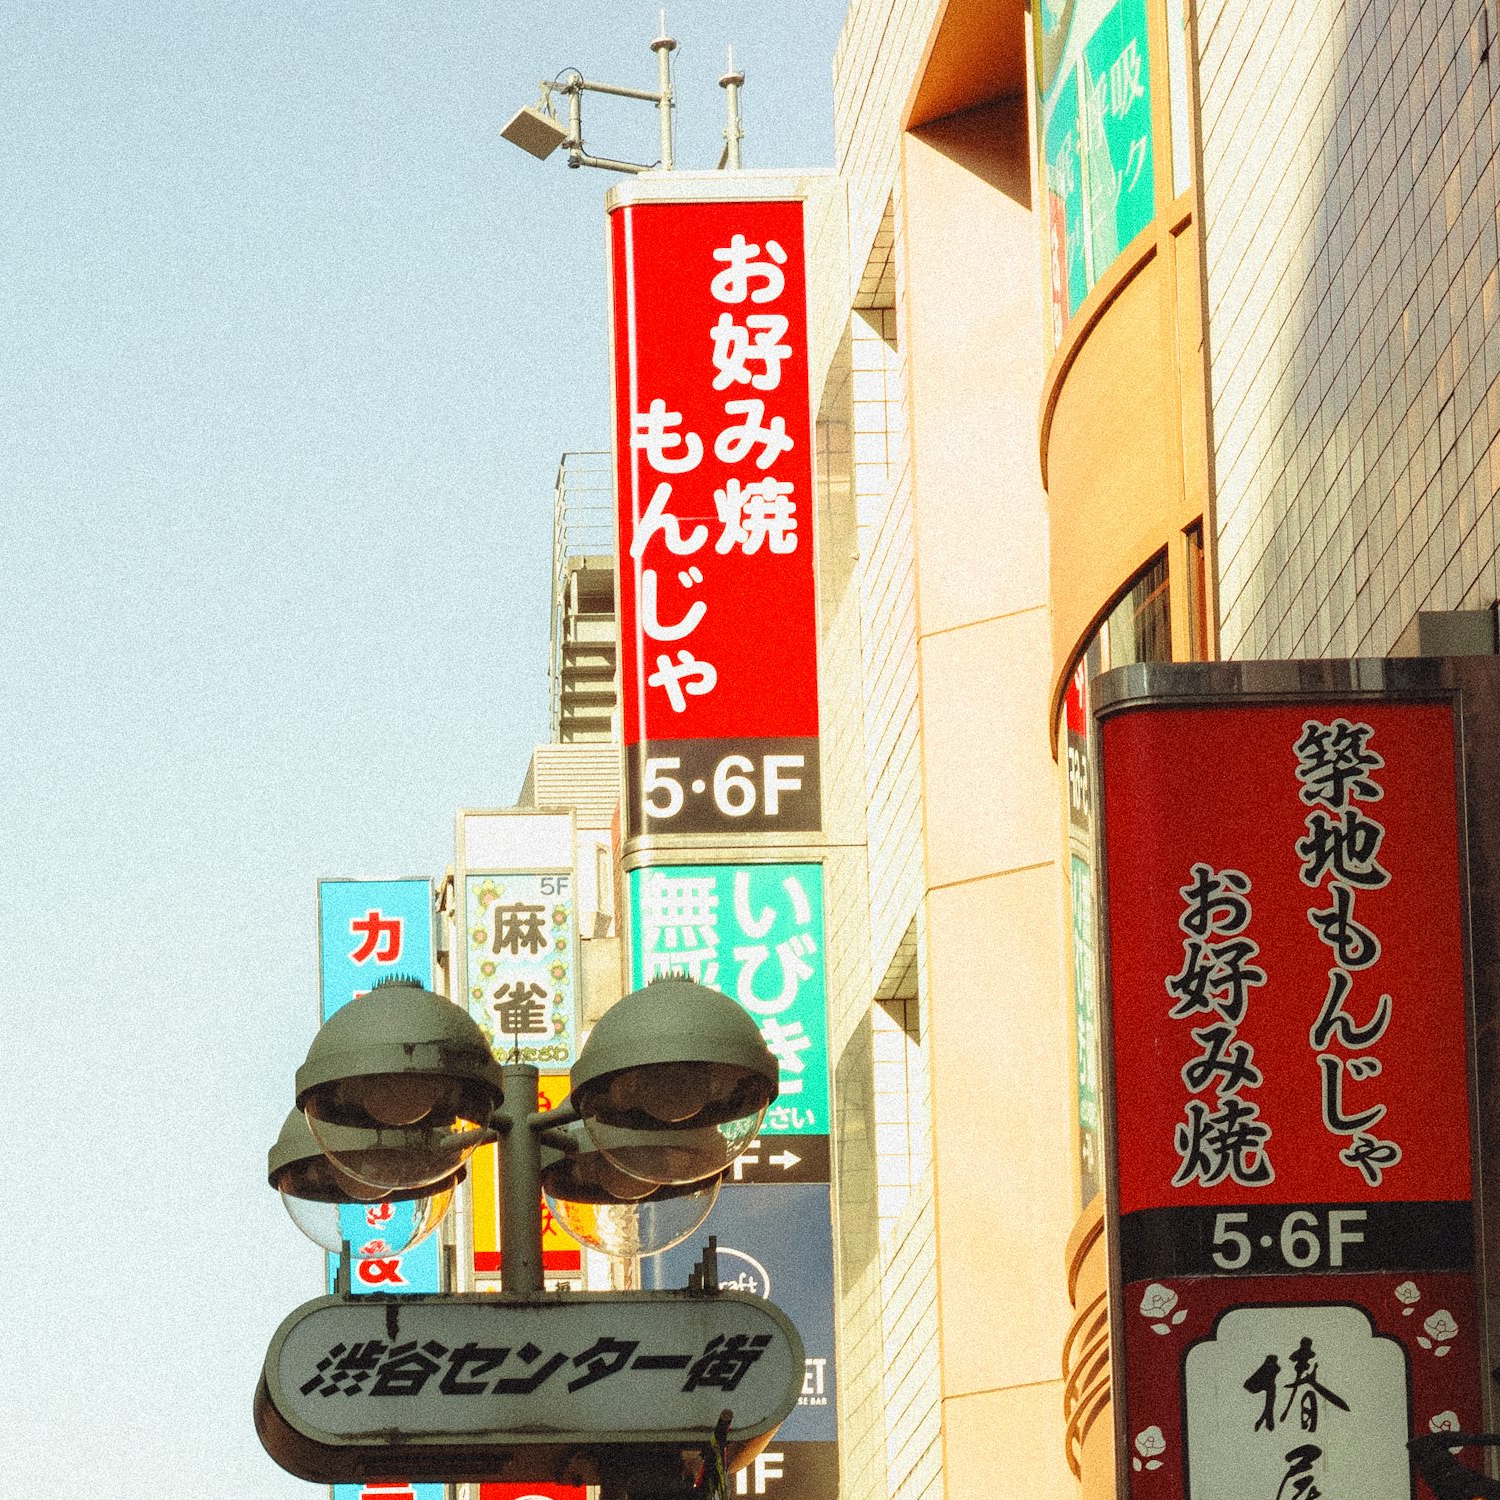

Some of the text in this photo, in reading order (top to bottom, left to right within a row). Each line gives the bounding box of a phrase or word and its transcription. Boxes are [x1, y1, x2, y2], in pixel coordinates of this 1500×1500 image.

[710, 235, 799, 556] お好み焼
[630, 399, 718, 714] もんじゃ
[492, 903, 549, 1035] 麻雀
[540, 877, 570, 897] 5F
[1164, 861, 1275, 1189] お好み焼
[1293, 717, 1402, 1187] 築地もんじゃ
